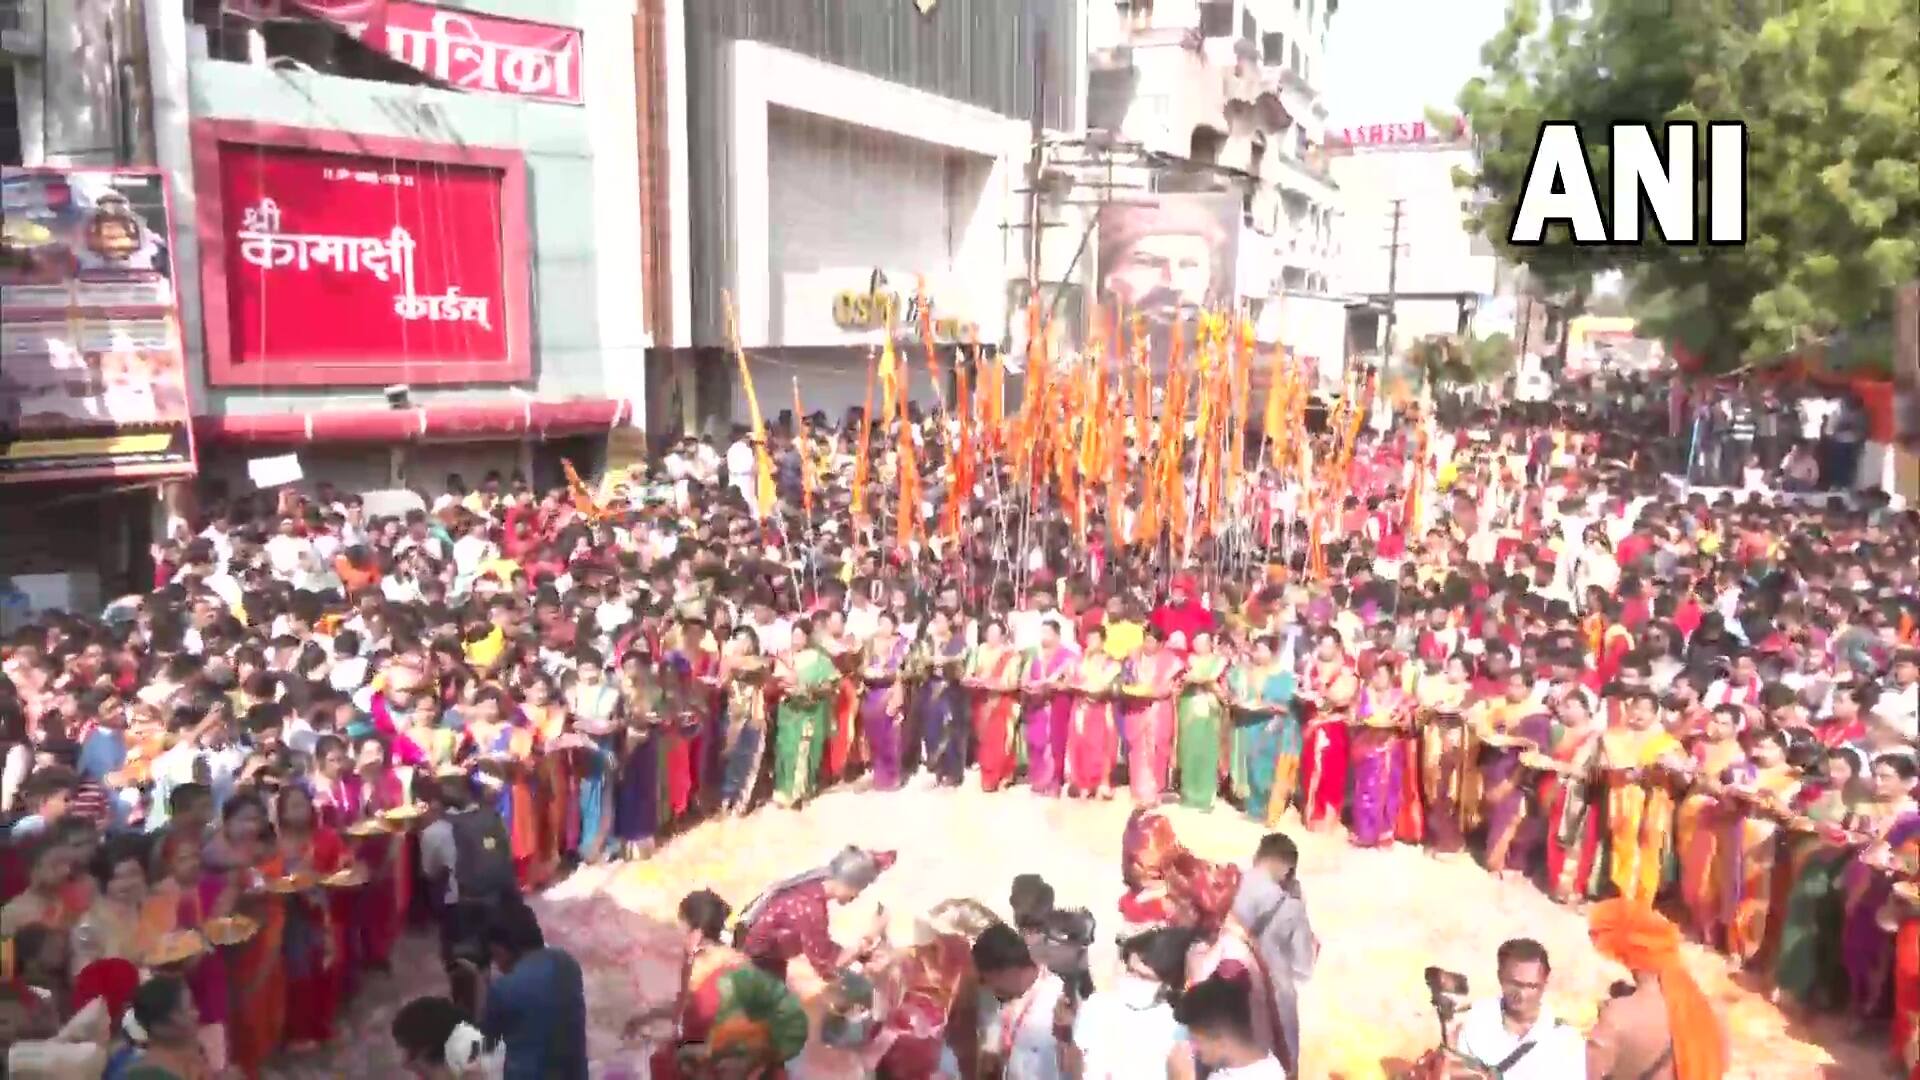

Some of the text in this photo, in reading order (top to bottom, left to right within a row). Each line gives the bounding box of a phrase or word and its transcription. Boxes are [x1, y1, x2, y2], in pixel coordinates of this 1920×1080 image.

[386, 10, 573, 96] पत्रिका
[243, 197, 282, 233] श्री
[237, 224, 416, 298] कामाक्षी
[393, 285, 492, 331] कार्डस्
